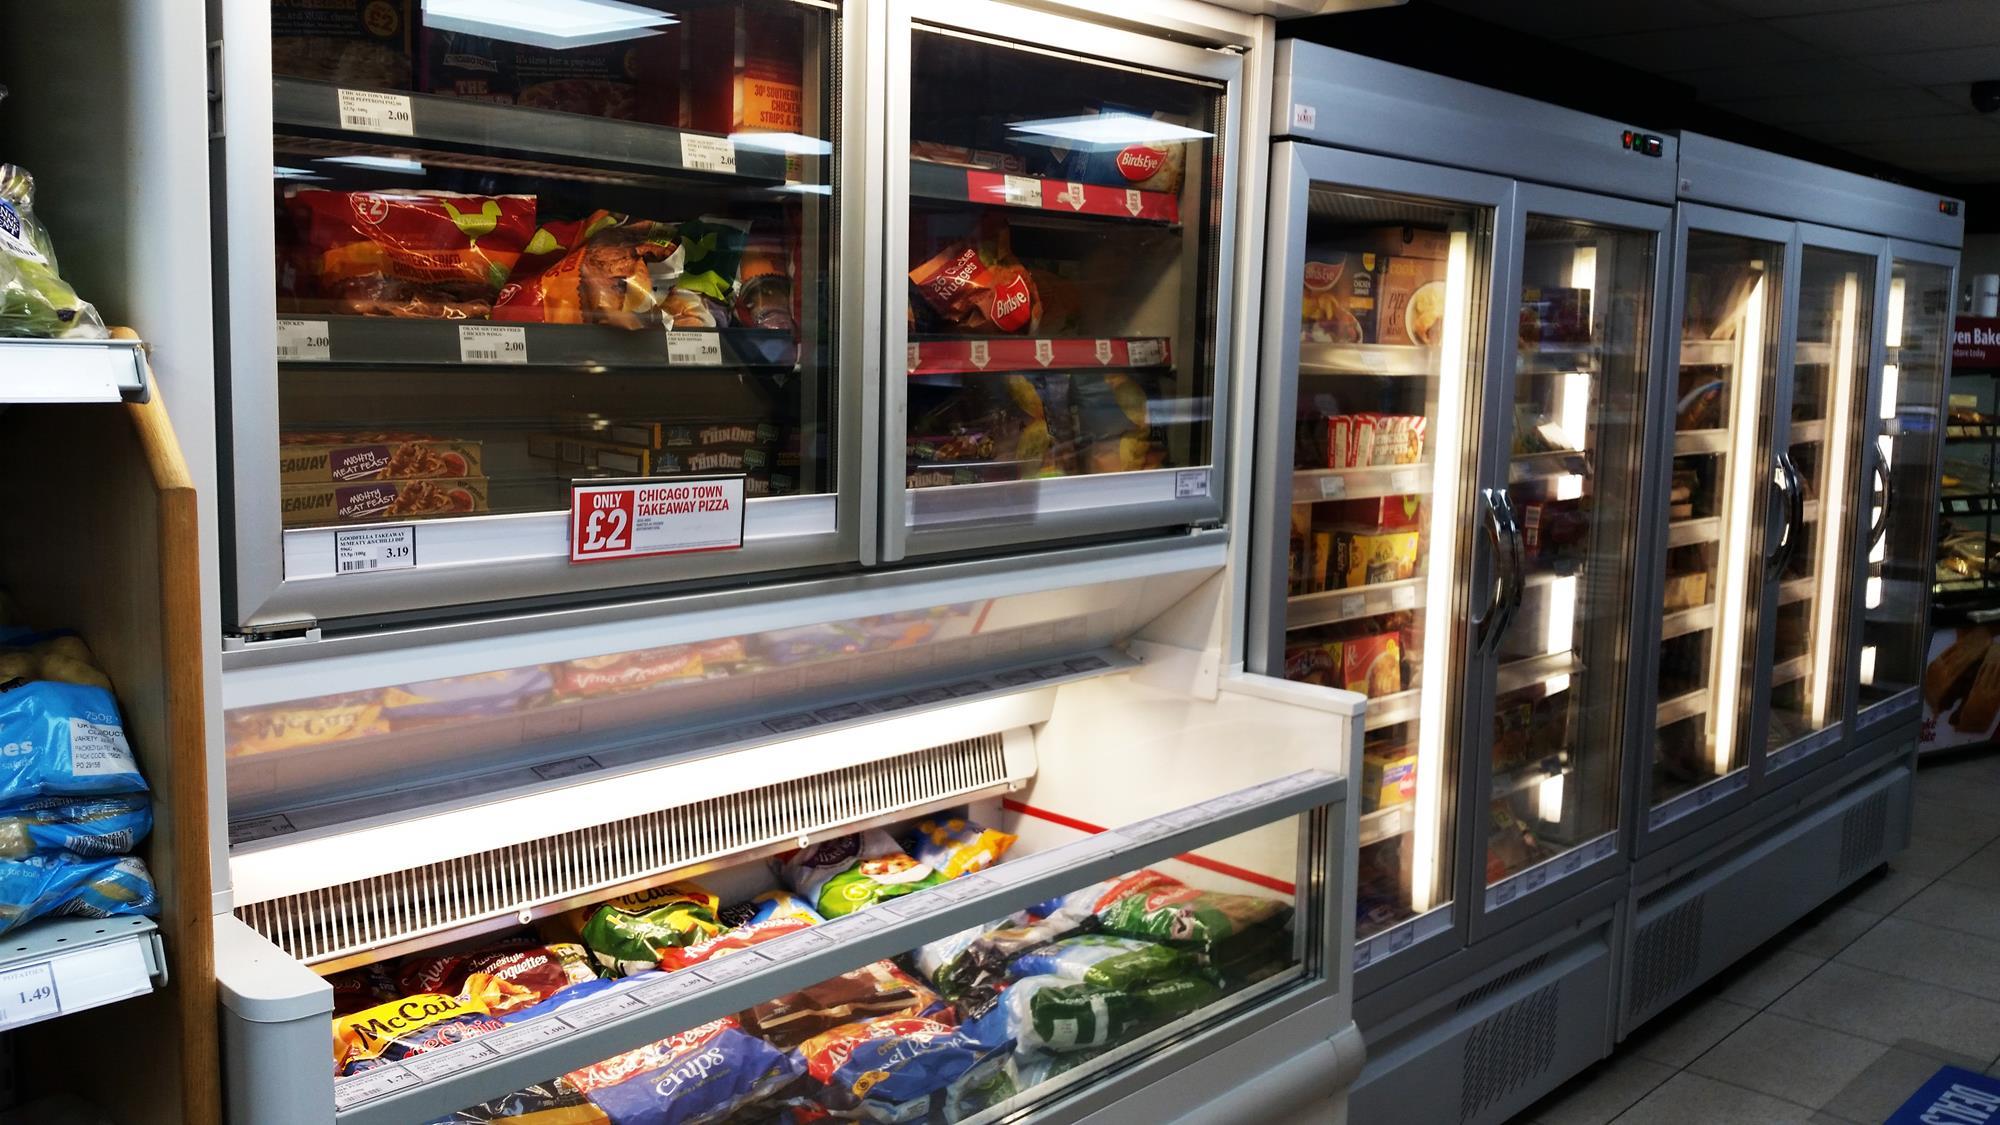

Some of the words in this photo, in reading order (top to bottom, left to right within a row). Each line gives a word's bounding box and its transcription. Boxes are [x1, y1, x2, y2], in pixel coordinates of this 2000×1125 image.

[388, 110, 409, 121] 2.00
[760, 111, 784, 125] STRIPS
[939, 262, 978, 301] Nuggets
[306, 336, 329, 347] 2.00
[505, 342, 524, 351] 2.00
[702, 346, 718, 354] 2.00
[281, 454, 328, 473] EAWAY
[343, 451, 375, 466] MIGHTY
[333, 464, 358, 478] MEAT
[360, 456, 389, 471] FEAST
[349, 488, 381, 504] MIGHTY
[594, 493, 622, 508] ONLY
[639, 487, 690, 503] CHICAGO
[692, 485, 723, 499] TOWN
[339, 504, 364, 516] MEAT
[366, 494, 395, 508] FEAST
[638, 501, 696, 517] TAKEAWAY
[699, 499, 729, 512] PIZZA
[583, 509, 628, 550] £2
[386, 547, 409, 558] 3.19
[85, 711, 113, 724] 750g
[495, 954, 549, 985] oquettes
[18, 986, 50, 1004] 1.49
[386, 1071, 413, 1085] 1.75
